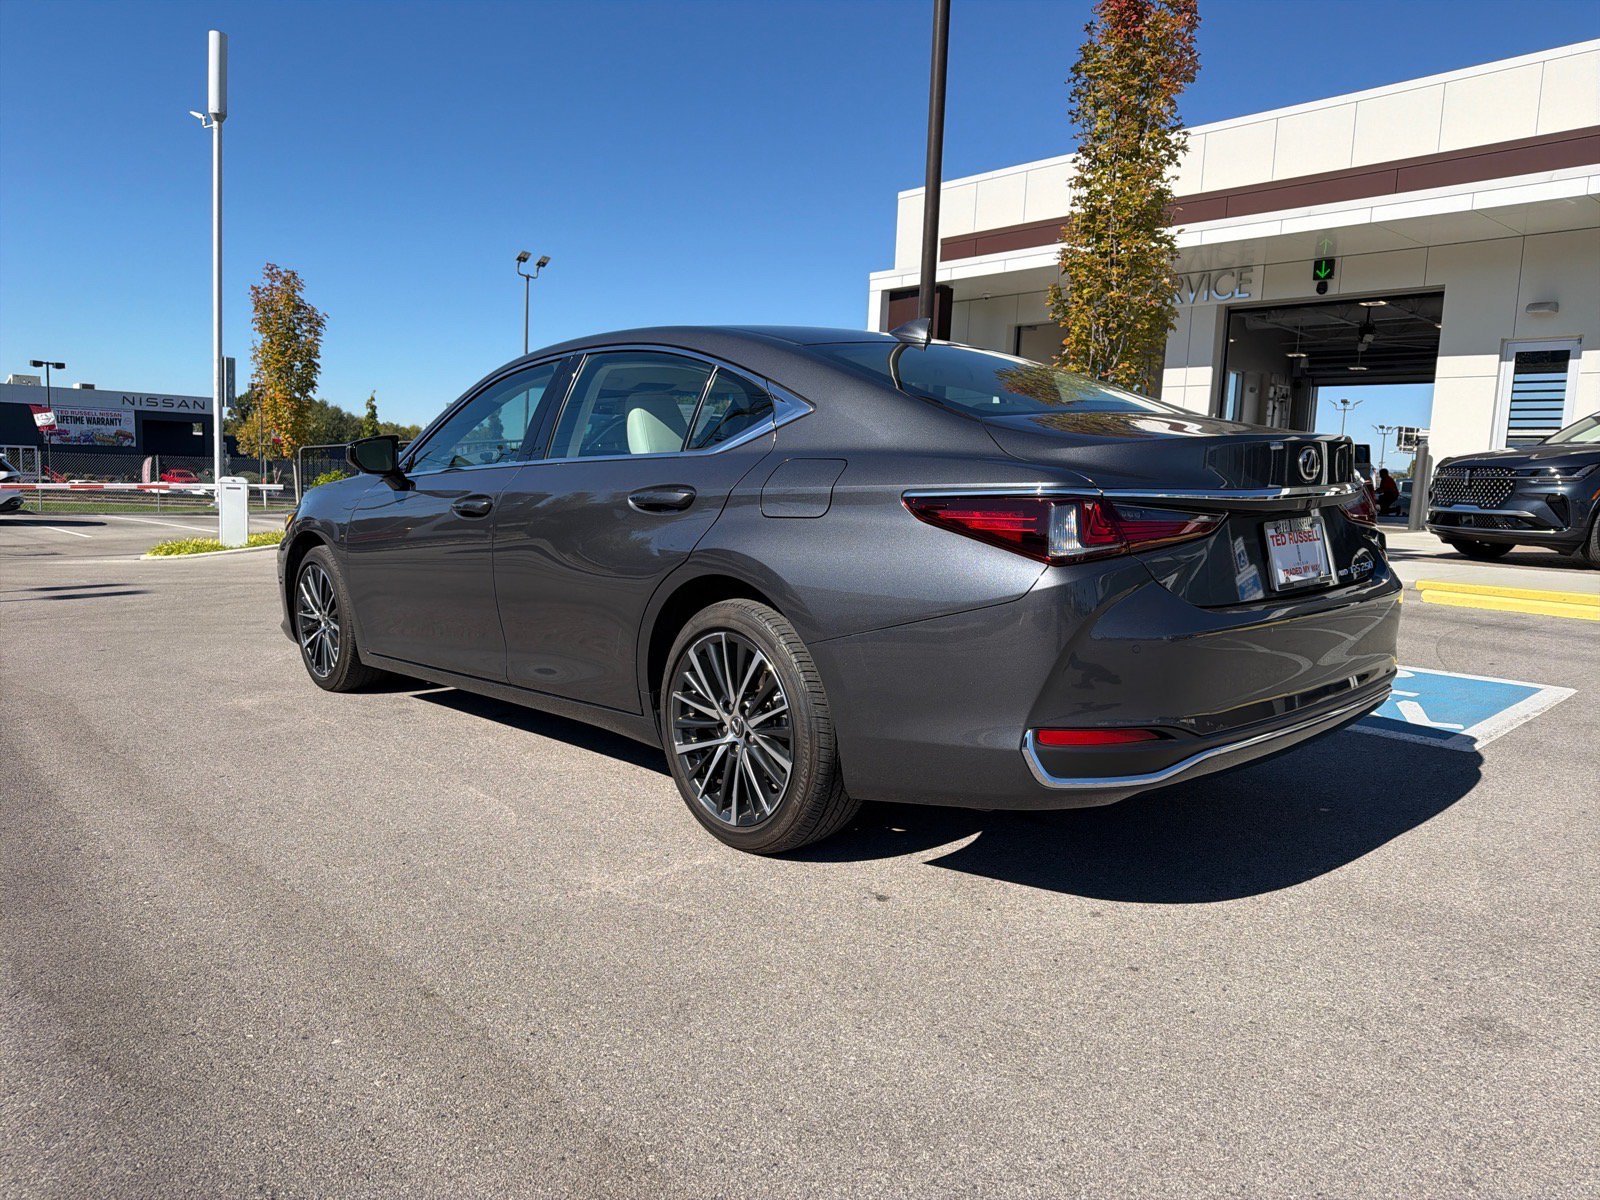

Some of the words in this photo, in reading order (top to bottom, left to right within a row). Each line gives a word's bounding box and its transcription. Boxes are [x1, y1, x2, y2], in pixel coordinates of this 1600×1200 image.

[1168, 267, 1253, 305] RVICE
[122, 395, 206, 410] NISSAN
[56, 415, 85, 425] LIFETIME
[86, 416, 122, 427] WARRANTY
[1270, 533, 1287, 547] TED
[1288, 529, 1321, 545] RUSSELL
[1283, 566, 1303, 577] TRADED
[1302, 564, 1311, 573] MY
